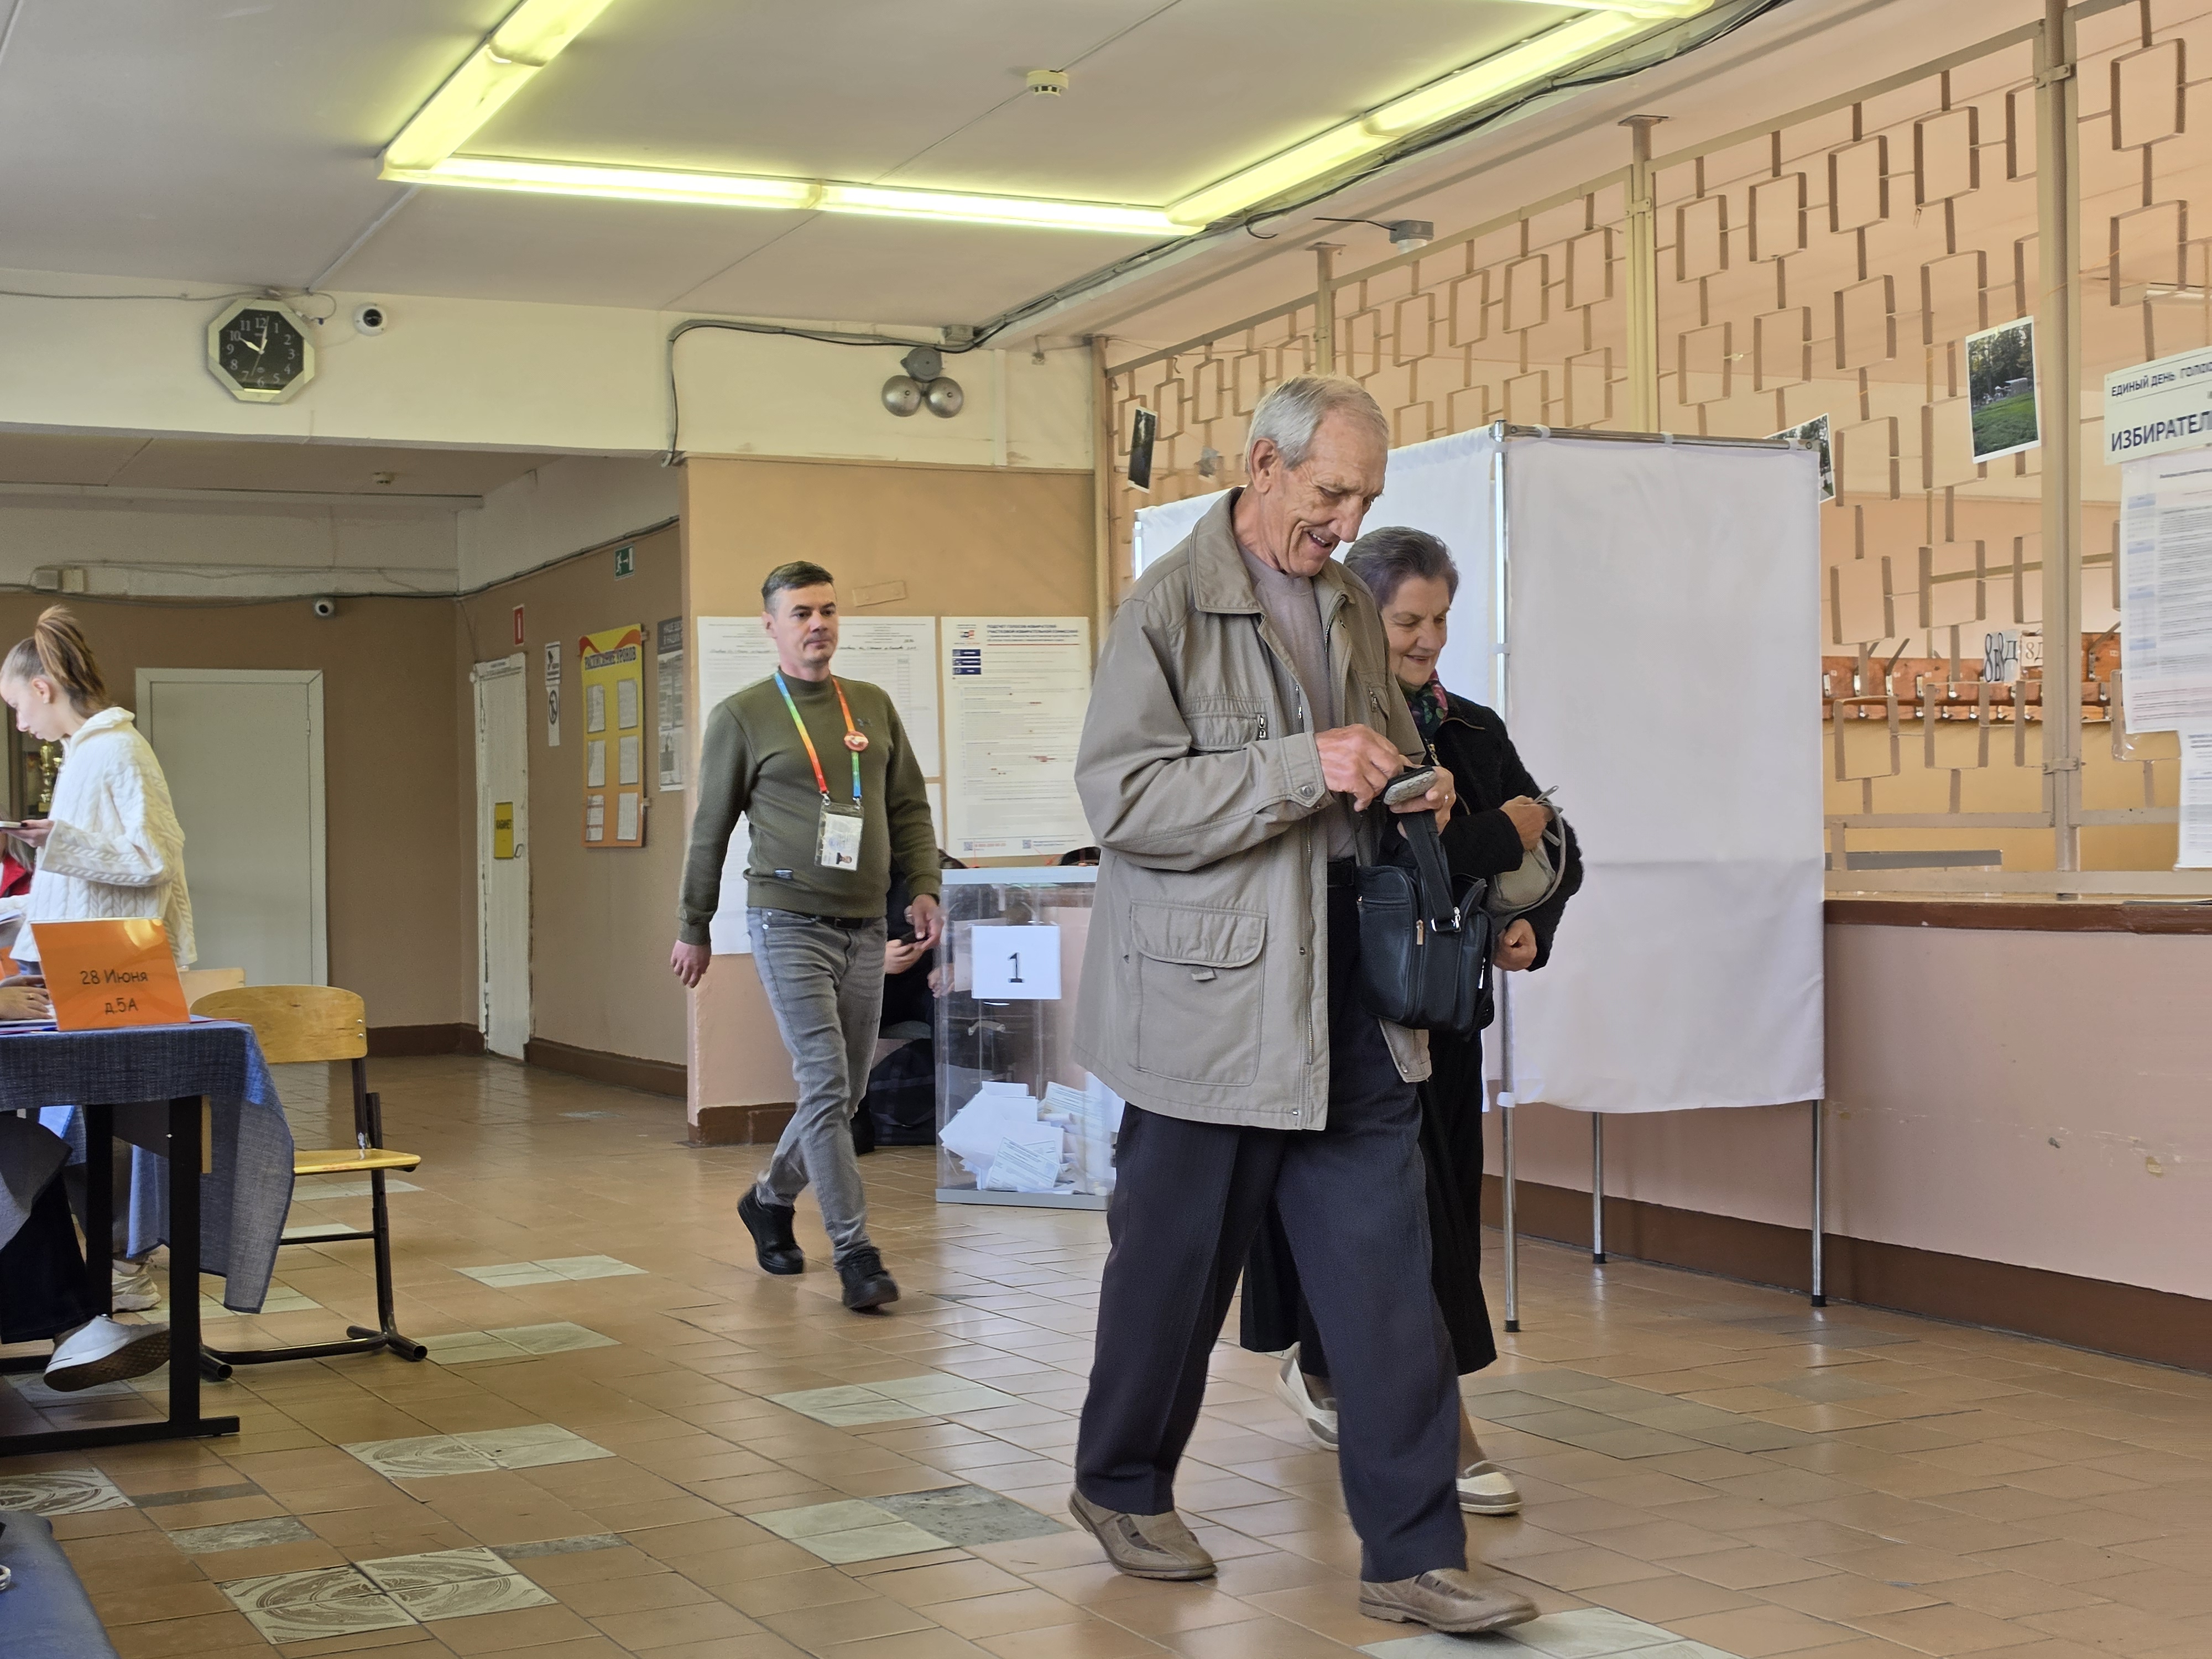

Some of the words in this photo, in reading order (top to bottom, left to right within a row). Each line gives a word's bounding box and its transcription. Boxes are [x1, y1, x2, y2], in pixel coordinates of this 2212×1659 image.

[240, 320, 251, 331] 11
[255, 317, 267, 329] 12
[274, 322, 279, 333] 1
[230, 330, 242, 341] 10
[284, 334, 291, 345] 2
[227, 343, 234, 354] 9
[288, 348, 295, 360] 3
[230, 358, 238, 370] 8
[284, 363, 291, 374] 4
[242, 371, 249, 381] 7
[273, 373, 280, 384] 5
[257, 376, 265, 388] 6
[2111, 375, 2149, 398] ЕДИНЫЙ
[2151, 372, 2176, 388] ДЕНЬ
[1008, 952, 1024, 983] 1
[80, 969, 101, 985] 28
[103, 968, 148, 983] Июня
